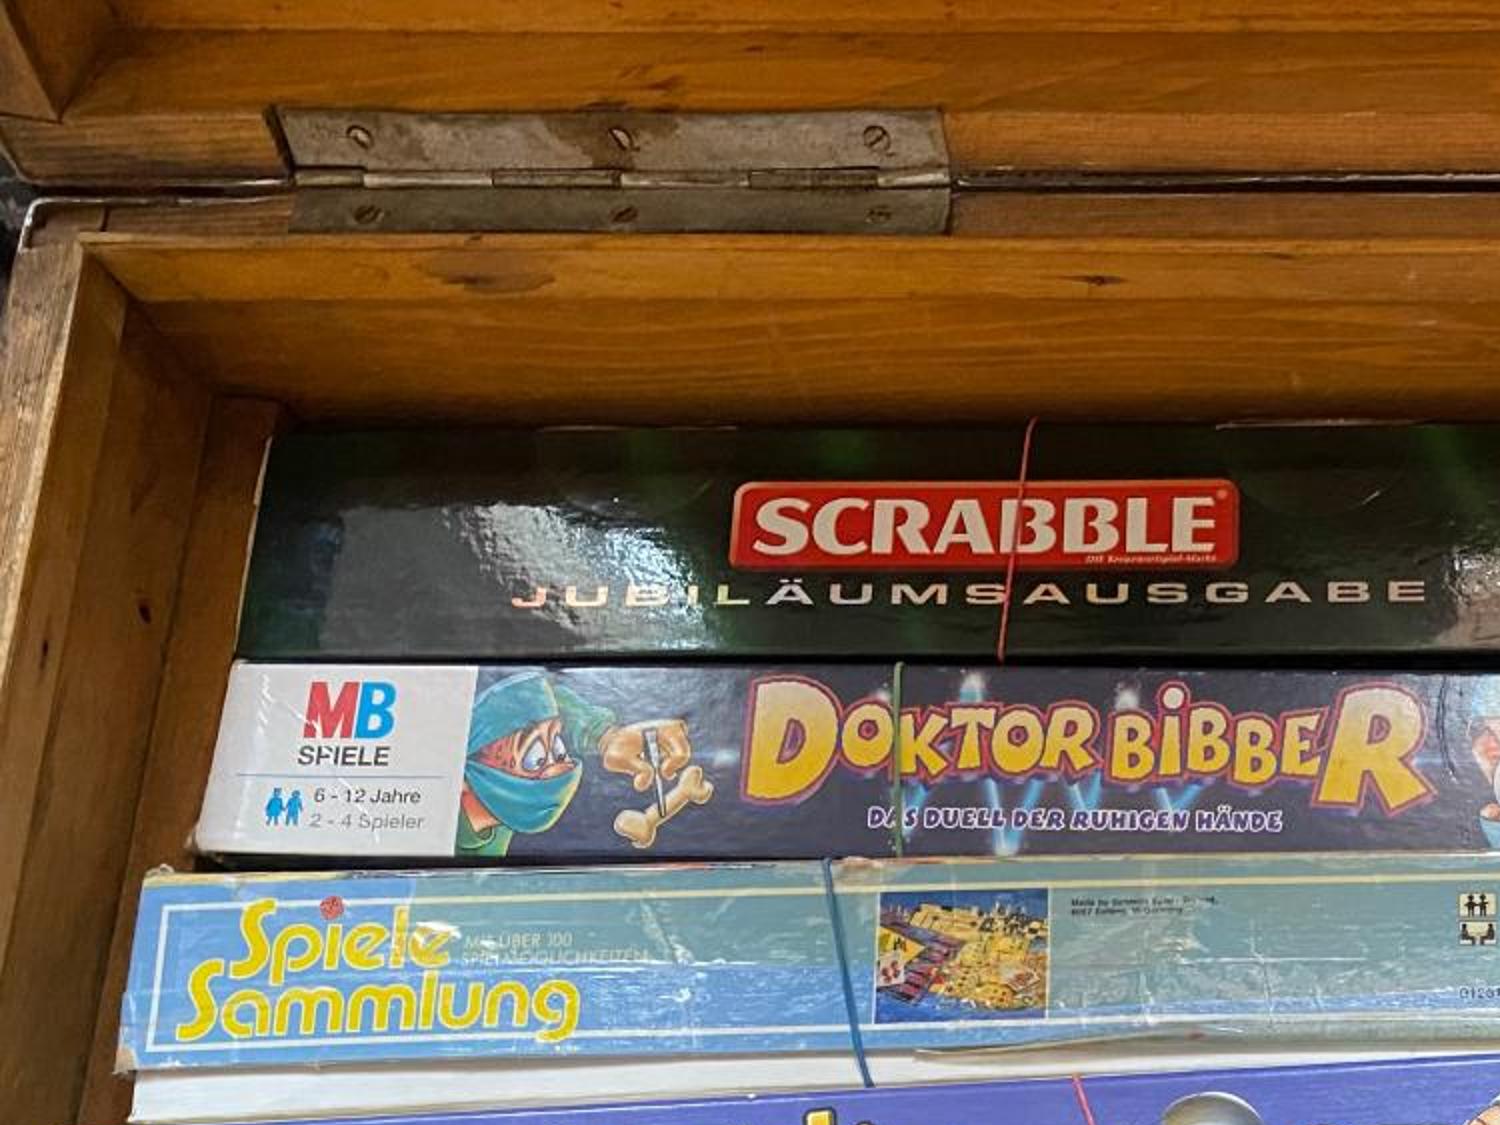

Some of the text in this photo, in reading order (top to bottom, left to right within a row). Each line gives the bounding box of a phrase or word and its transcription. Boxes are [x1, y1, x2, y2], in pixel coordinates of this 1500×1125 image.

[752, 496, 1216, 556] SCRABBLE
[511, 580, 1426, 607] JUBILÄUMSAUSGABE
[303, 681, 398, 739] MB
[297, 745, 391, 768] SPIELE
[742, 674, 1101, 805] DOKTOR
[314, 787, 326, 804] 6
[369, 788, 422, 804] Jahre
[308, 813, 321, 829] 2
[341, 813, 353, 829] 4
[358, 813, 425, 832] Spieler
[923, 806, 1006, 829] DUELL
[1011, 807, 1066, 830] DER
[1070, 808, 1190, 832] RUHIGEN
[1196, 805, 1284, 832] HÄNDE
[229, 899, 454, 987] Spiele
[176, 958, 580, 1043] Sammlung
